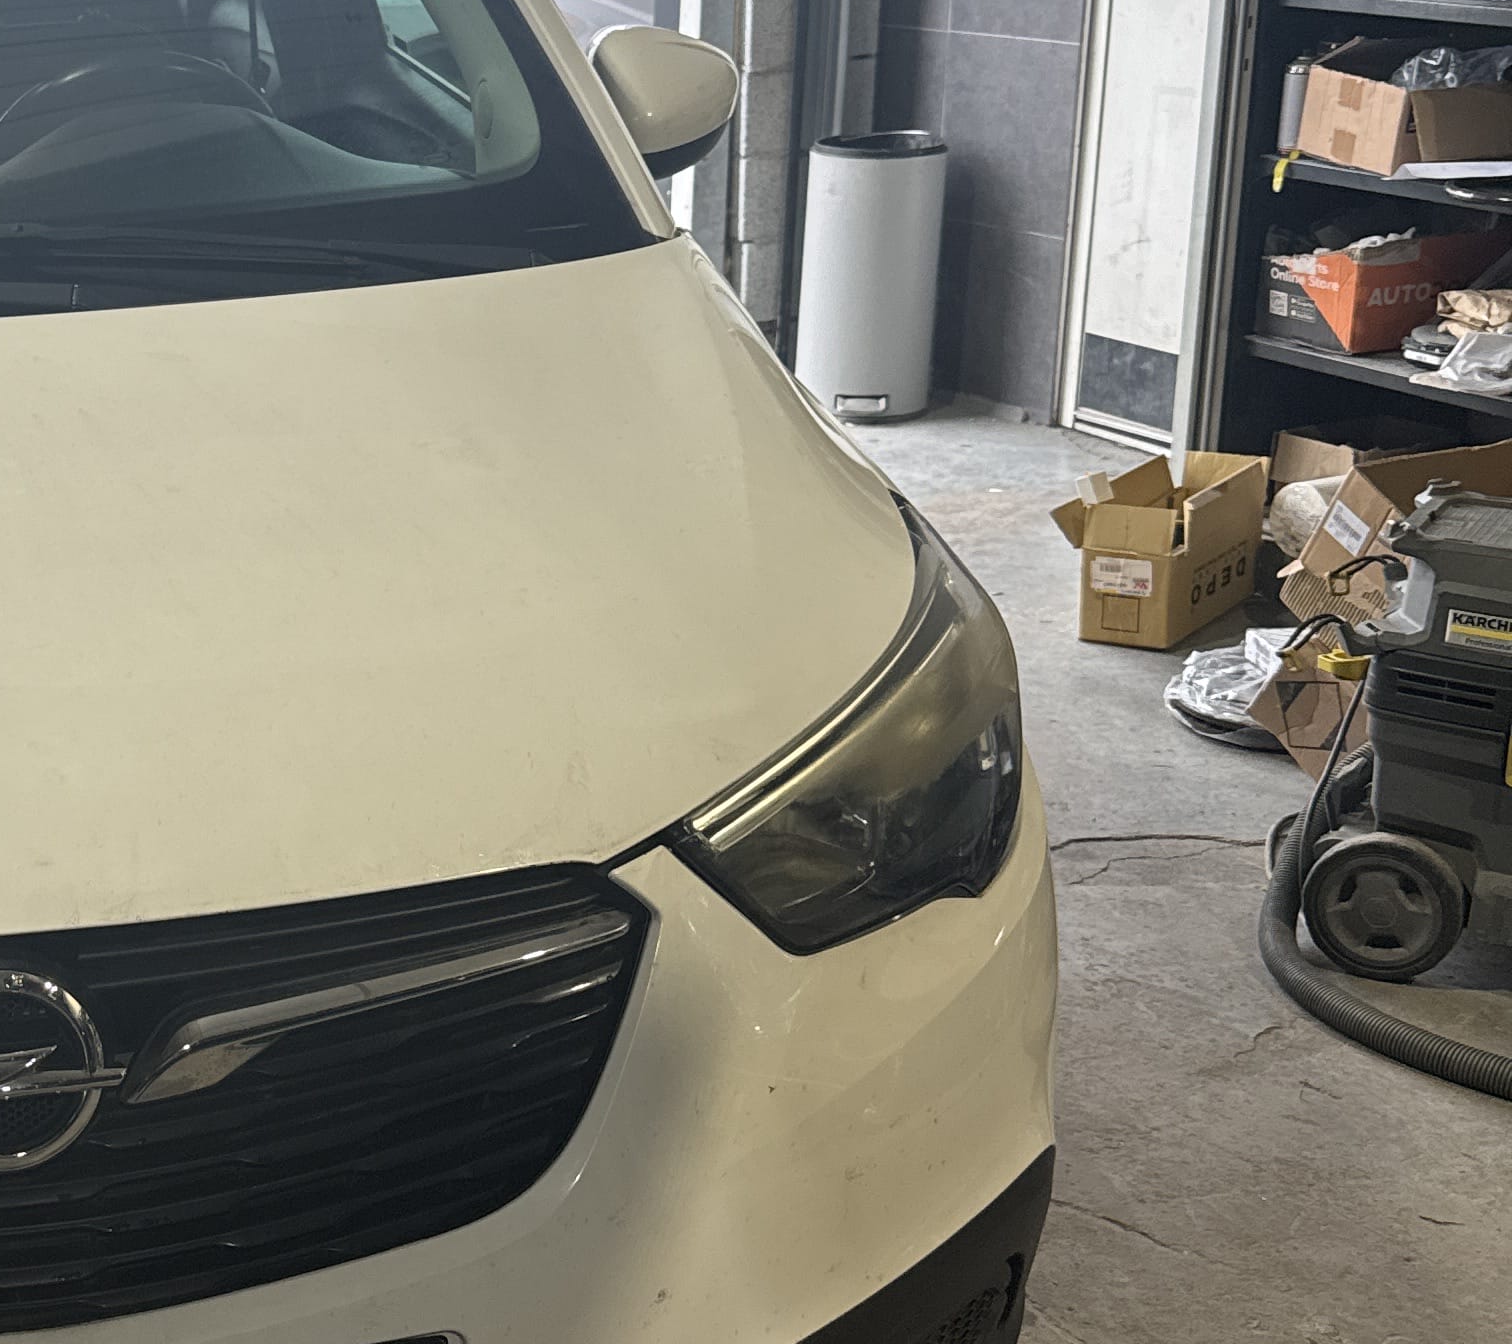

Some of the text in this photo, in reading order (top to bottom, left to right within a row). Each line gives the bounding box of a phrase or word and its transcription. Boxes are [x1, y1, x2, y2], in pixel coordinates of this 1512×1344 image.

[1270, 267, 1340, 292] Online Store
[1191, 556, 1246, 604] DEPO
